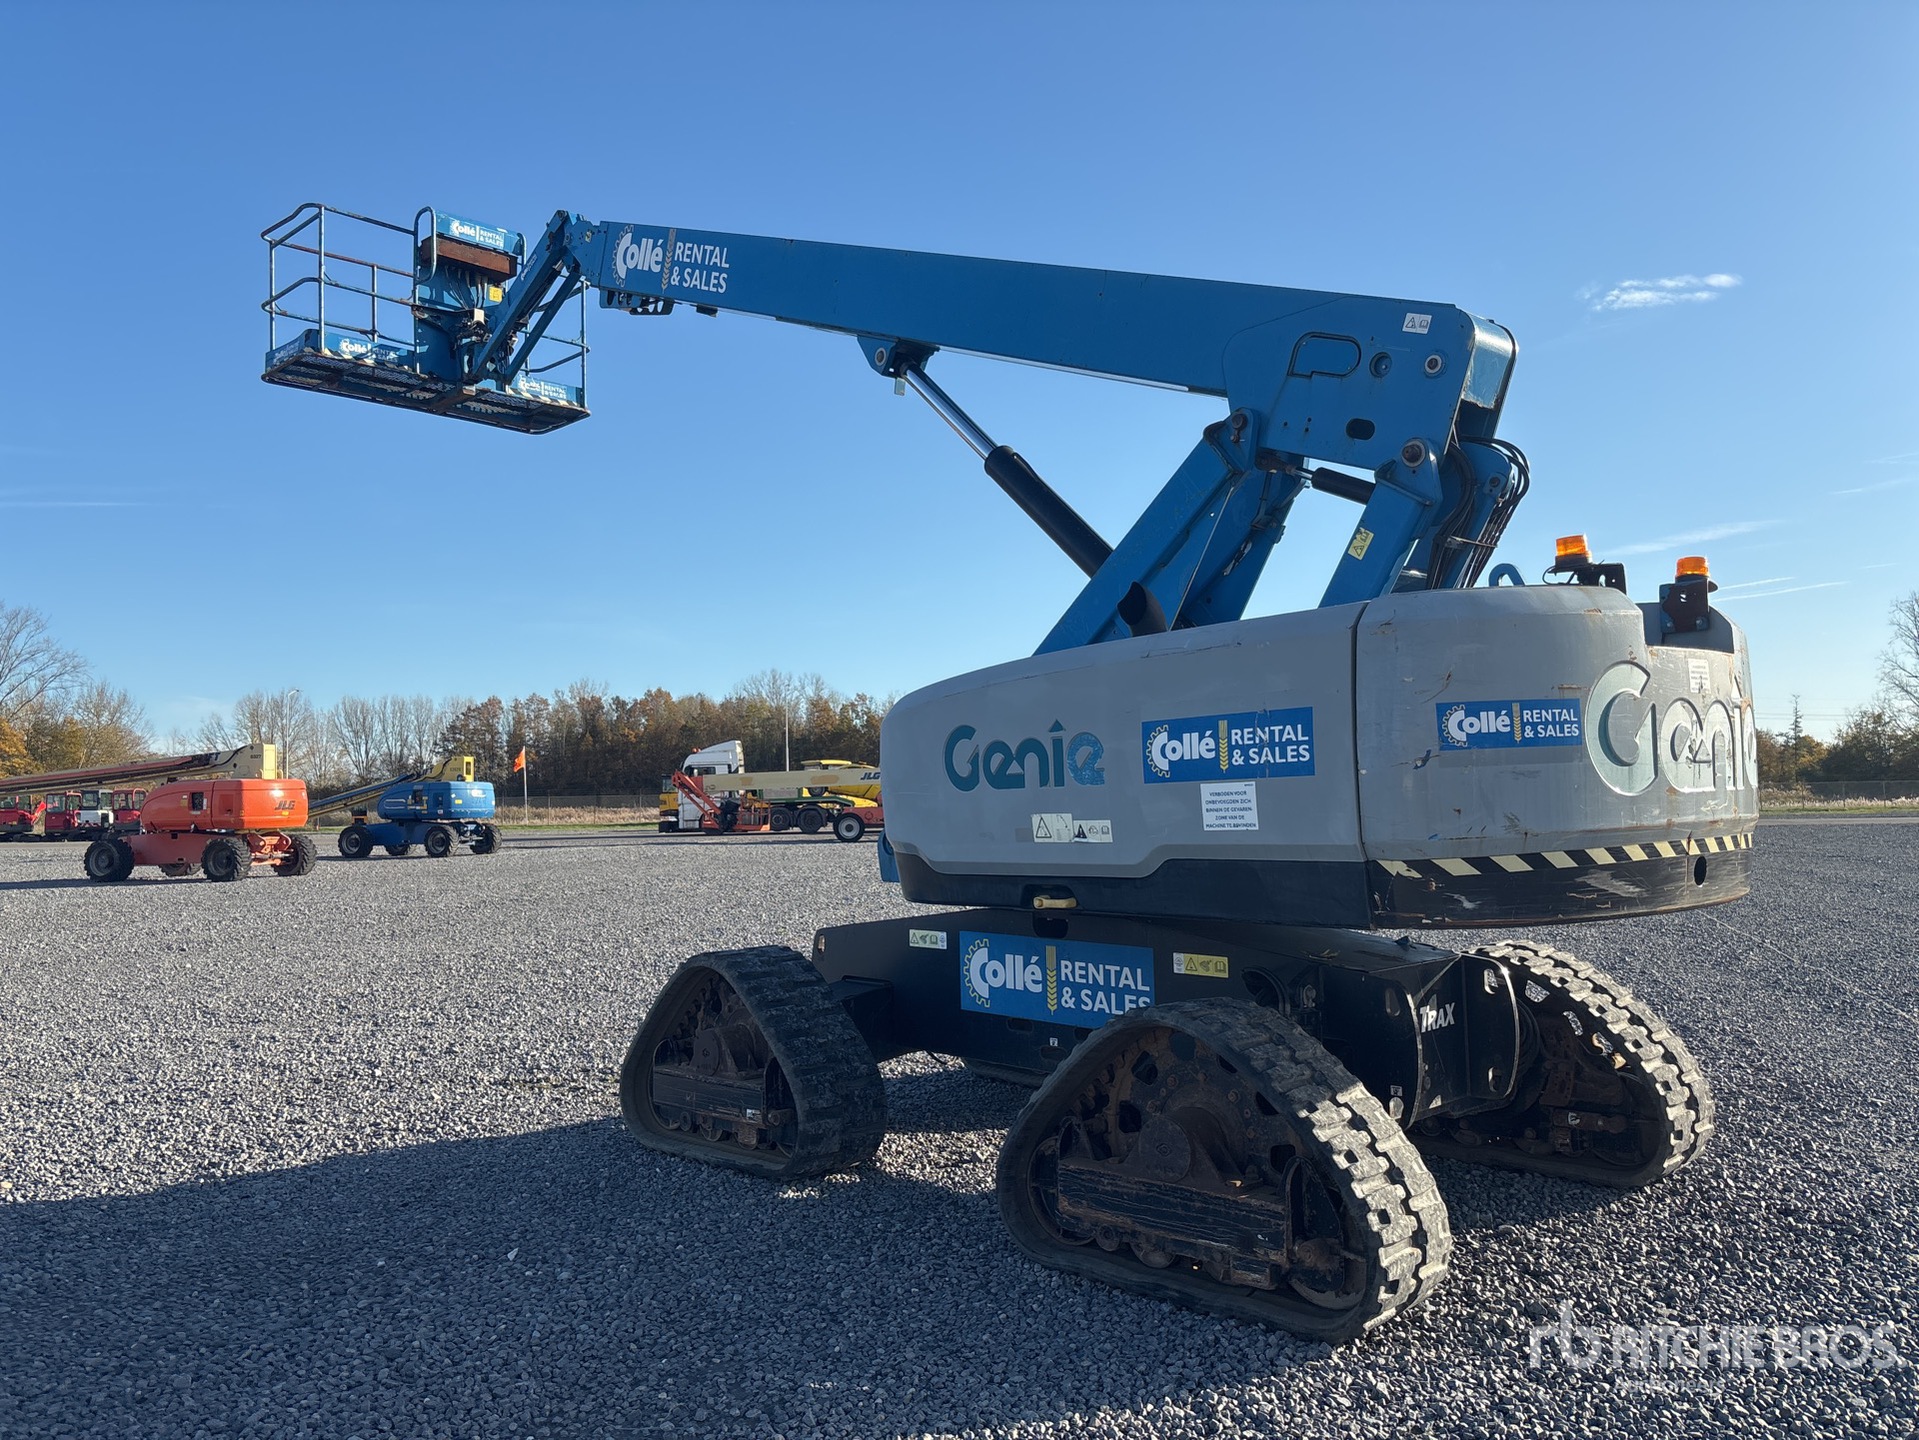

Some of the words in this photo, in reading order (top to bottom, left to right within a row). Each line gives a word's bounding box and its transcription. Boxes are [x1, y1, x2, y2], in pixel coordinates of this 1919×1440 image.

[480, 229, 504, 241] RENTAL
[616, 232, 664, 279] Collé
[674, 241, 730, 268] RENTAL
[670, 266, 681, 287] &
[682, 267, 728, 294] SALES
[1451, 708, 1512, 742] Collé
[1523, 708, 1579, 722] RENTAL
[1231, 724, 1309, 746] RENTAL
[1523, 725, 1535, 738] &
[1537, 723, 1580, 738] SALES
[944, 719, 1105, 792] Genie
[1151, 730, 1216, 771] Collé
[1231, 749, 1245, 766] &
[1249, 745, 1311, 765] SALES
[860, 771, 881, 781] JLG
[274, 800, 296, 811] JLG
[970, 947, 1043, 999] Collé
[1060, 960, 1150, 991] RENTAL
[1060, 987, 1076, 1009] &
[1080, 988, 1150, 1016] SALES
[1419, 1002, 1457, 1034] TRAX
